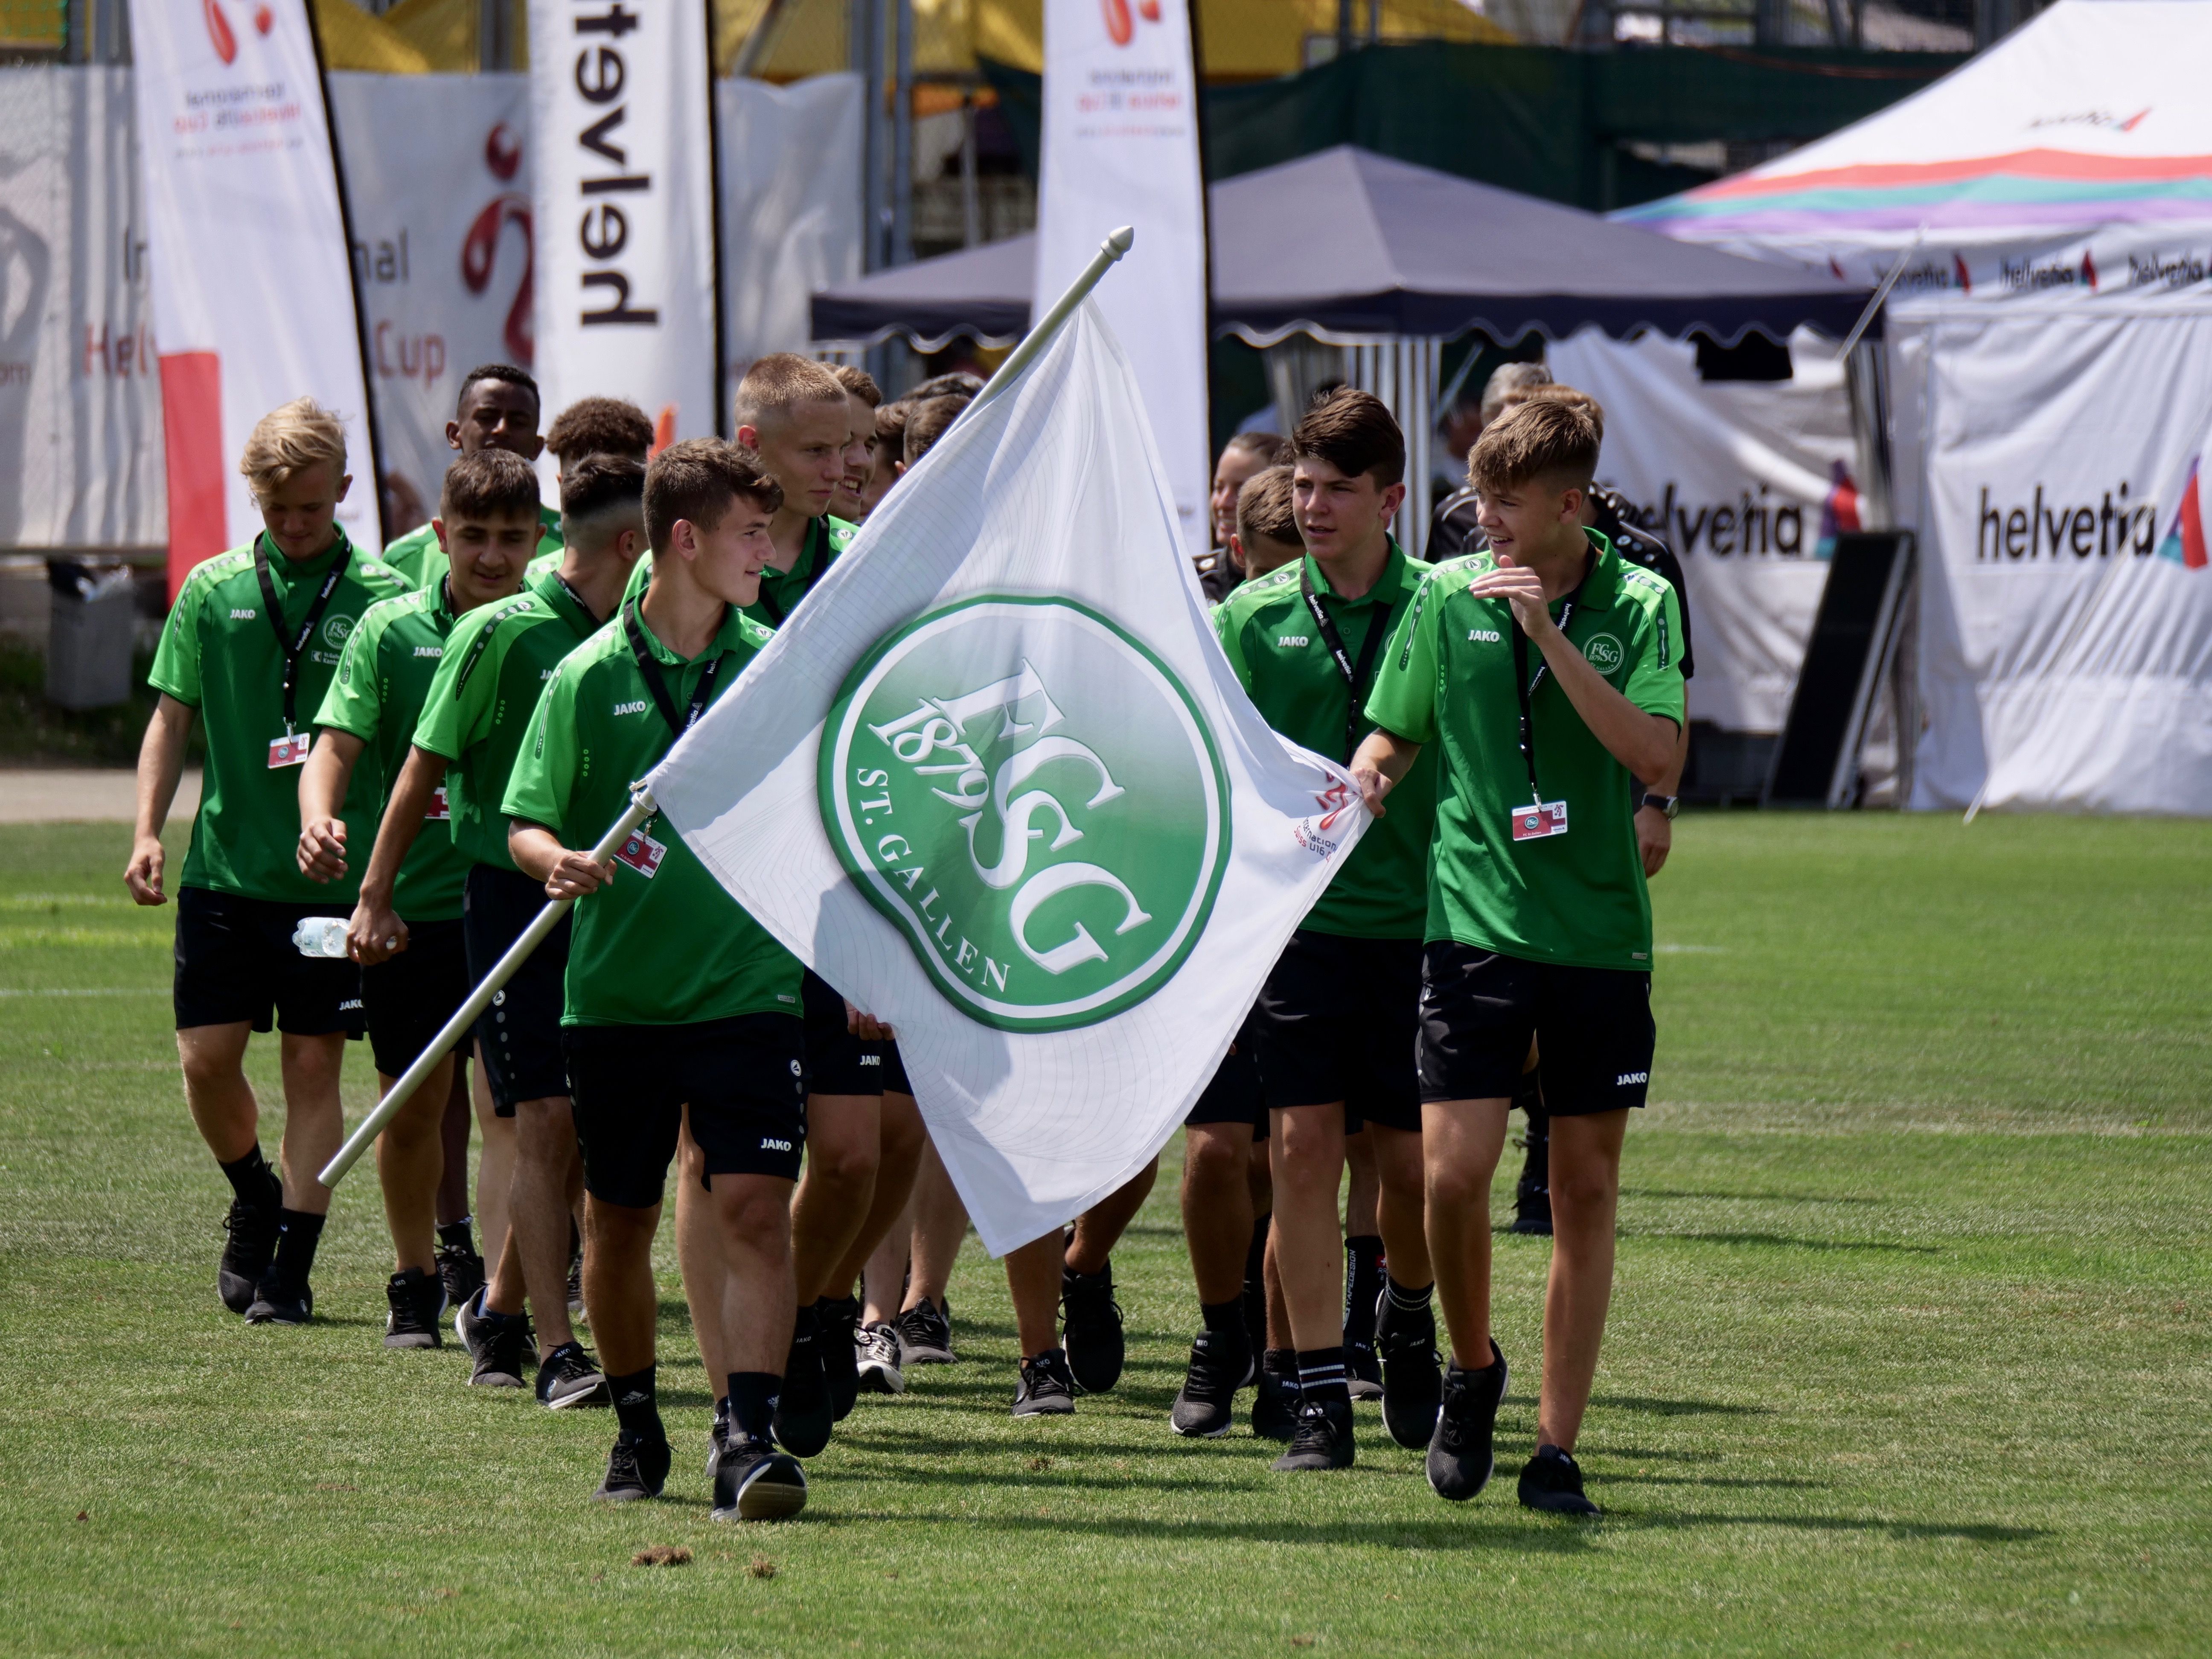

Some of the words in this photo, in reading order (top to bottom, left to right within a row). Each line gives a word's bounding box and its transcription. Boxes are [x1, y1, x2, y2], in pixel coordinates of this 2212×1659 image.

[574, 2, 660, 327] helvet
[374, 319, 446, 390] Cup
[1978, 481, 2156, 561] helvetia
[230, 608, 256, 620] JAKO
[1308, 594, 1324, 619] helvetia
[1558, 603, 1572, 631] helvetia
[1278, 636, 1308, 647] JAKO
[1468, 629, 1500, 642] JAKO
[413, 646, 443, 658] JAKO
[1336, 649, 1352, 674] helvetia
[614, 701, 646, 716] JAKO
[867, 698, 991, 810] 1879
[1310, 842, 1325, 856] U16
[857, 767, 894, 826] ST.
[878, 833, 1012, 992] GALLEN
[860, 1055, 880, 1066] JAKO
[1617, 1072, 1647, 1085] JAKO
[761, 1138, 792, 1152] JAKO
[1346, 1249, 1356, 1307] TAPEDESIGN
[1282, 1381, 1299, 1389] JAKO
